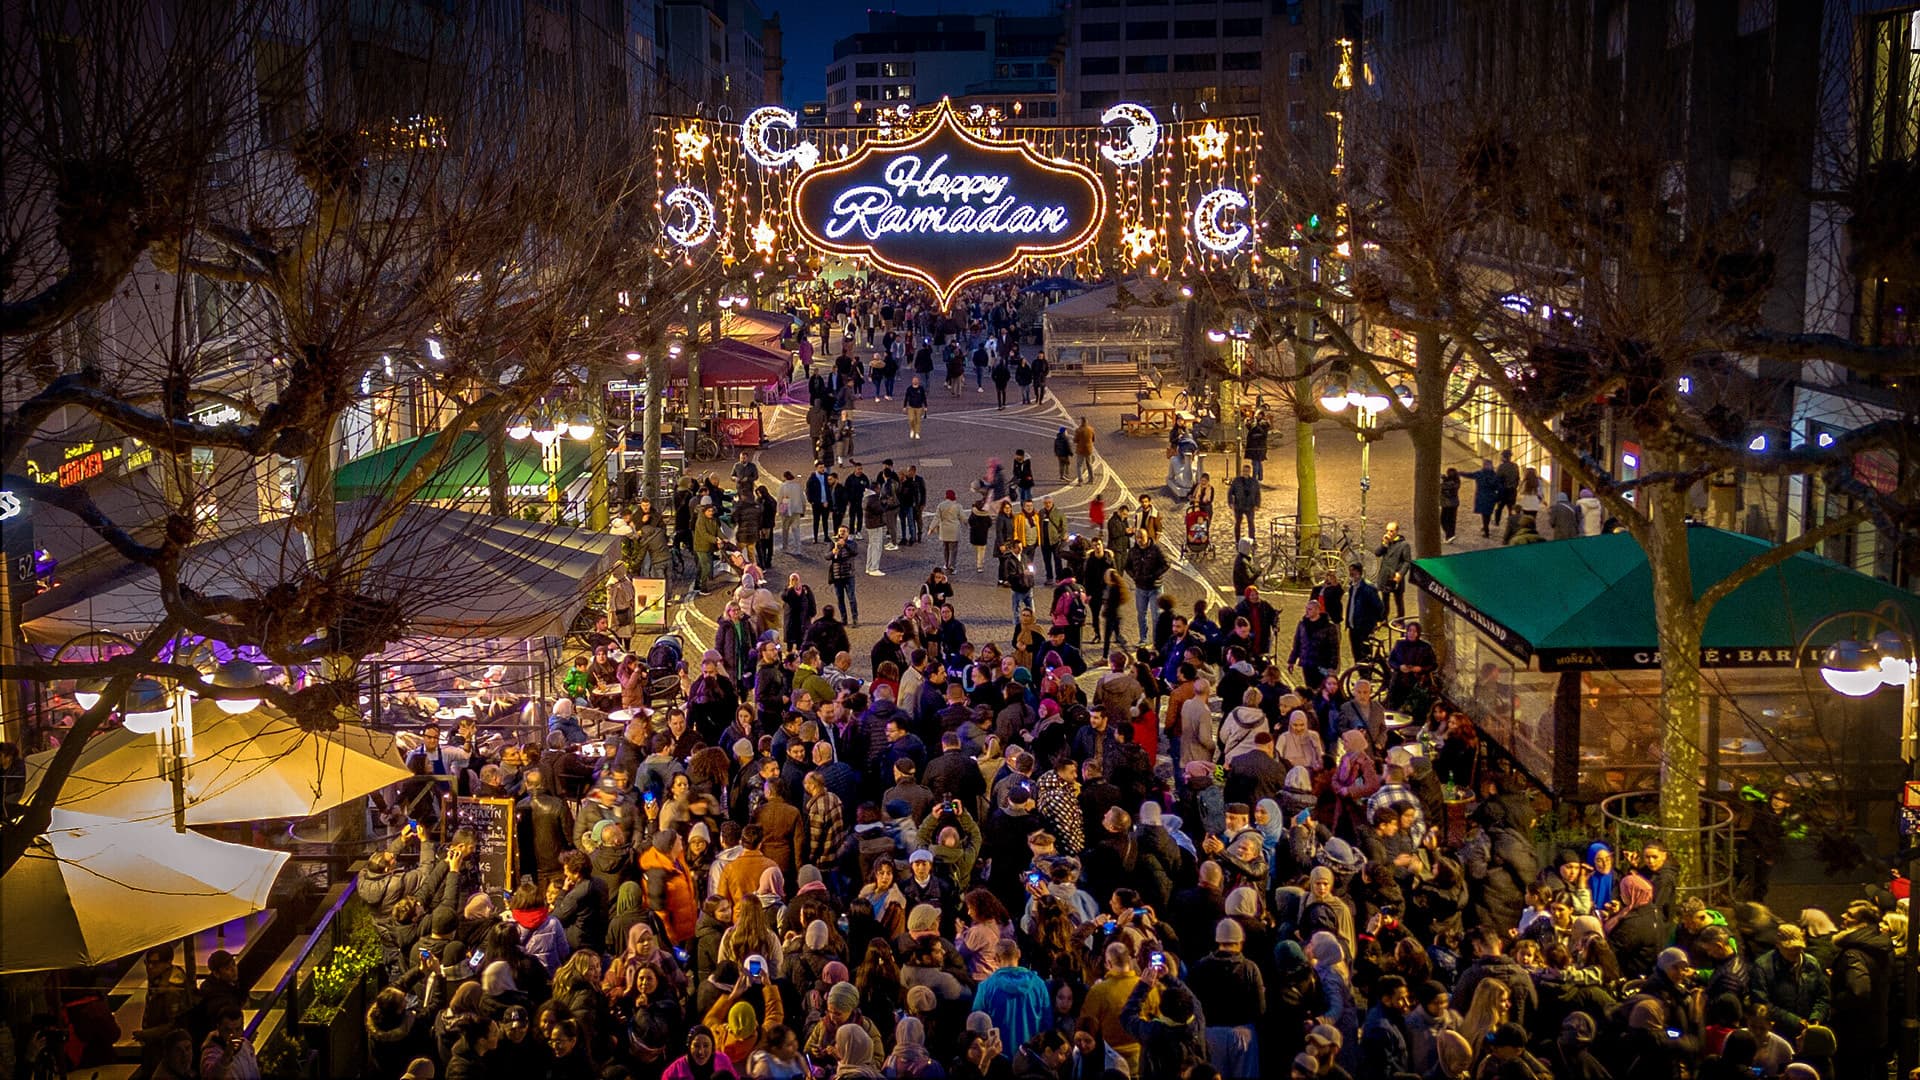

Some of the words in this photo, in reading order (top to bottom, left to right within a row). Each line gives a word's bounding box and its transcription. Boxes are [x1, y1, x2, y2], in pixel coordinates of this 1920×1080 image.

[885, 154, 1008, 203] Happy
[825, 185, 1069, 240] Ramadan
[463, 485, 549, 497] STAUCKS
[18, 553, 34, 581] 52
[1738, 650, 1792, 662] BAR
